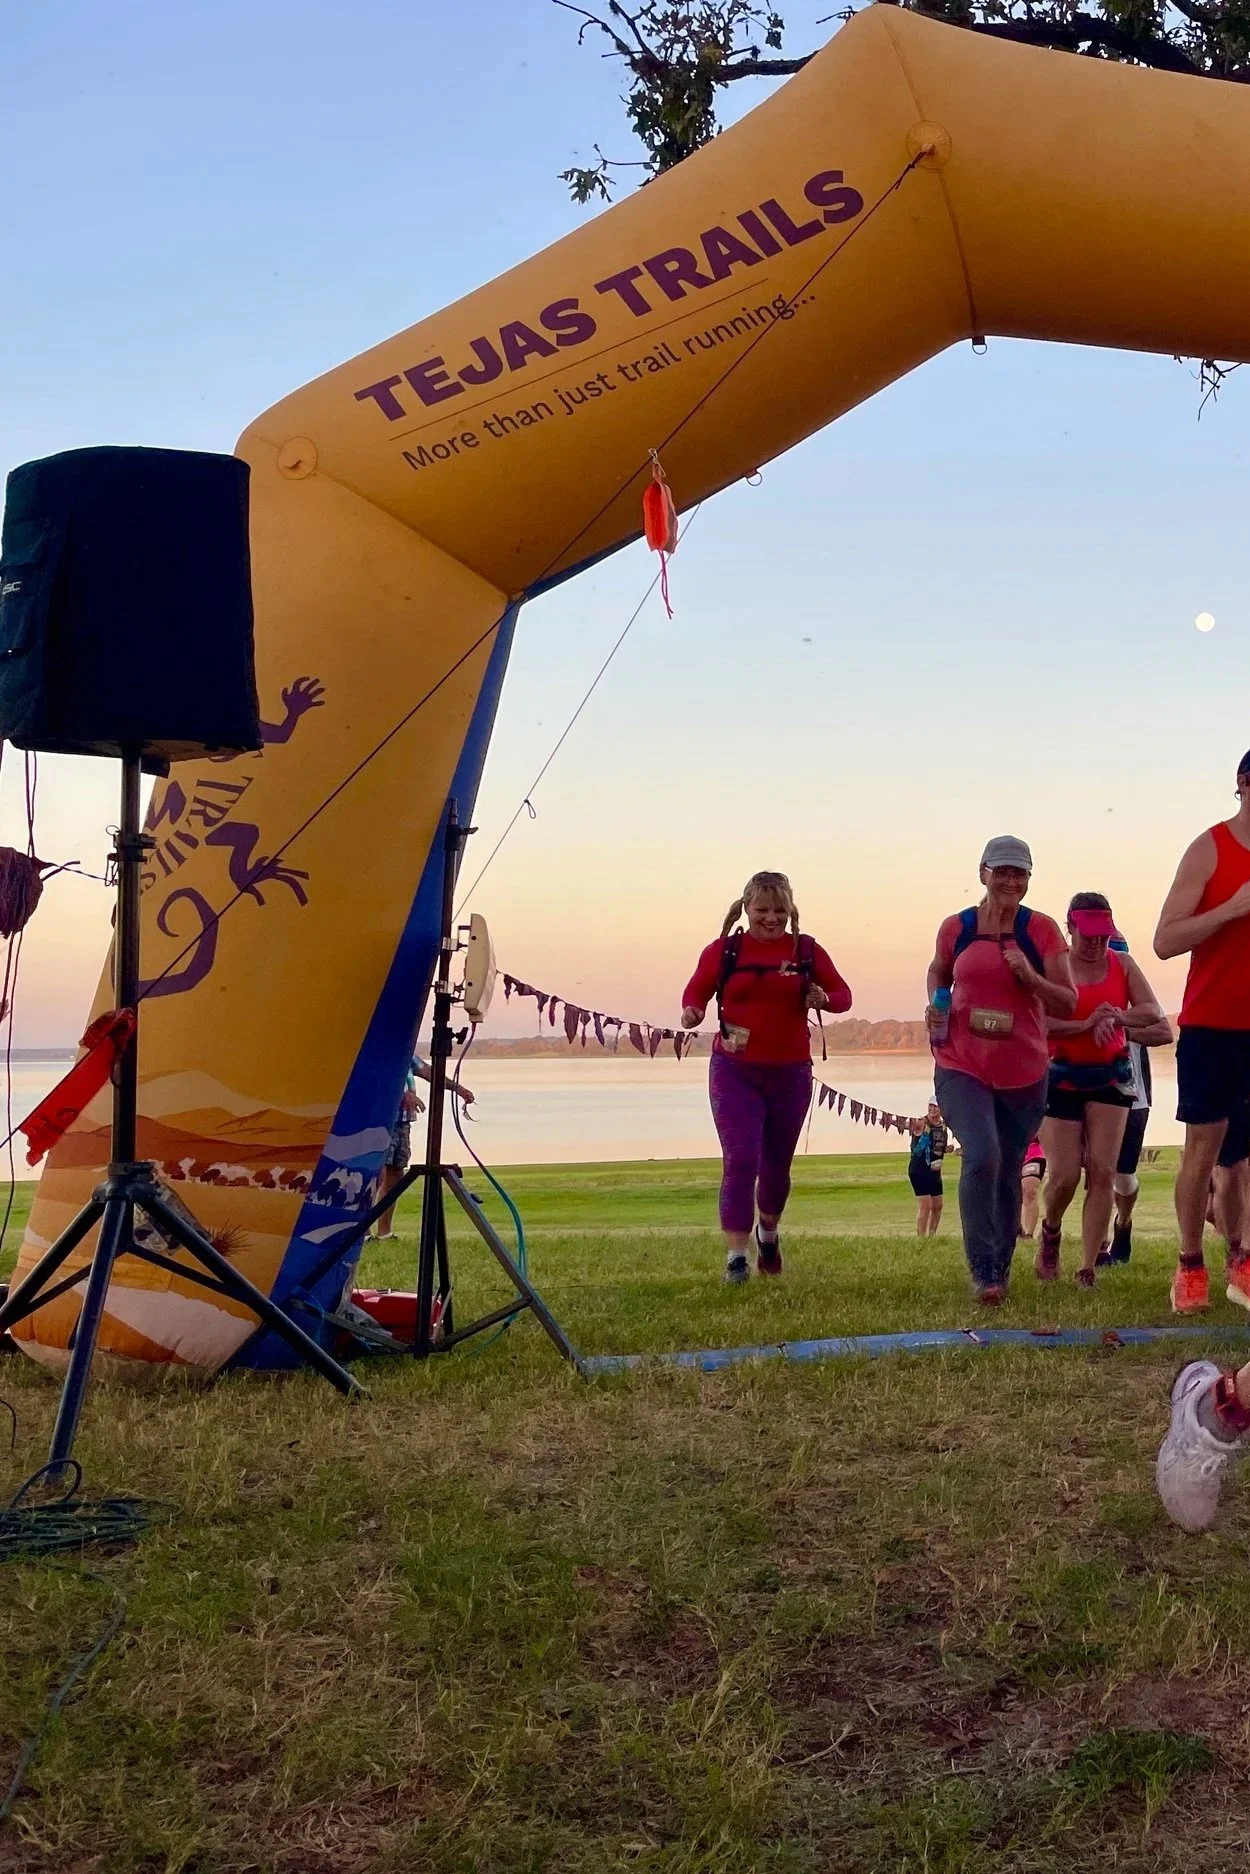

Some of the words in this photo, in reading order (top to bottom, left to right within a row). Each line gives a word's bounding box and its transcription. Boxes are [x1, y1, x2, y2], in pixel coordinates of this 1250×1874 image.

[354, 298, 598, 422] TEJAS
[594, 170, 864, 317] TRAILS
[402, 434, 480, 470] More
[483, 402, 554, 439] than
[559, 373, 616, 416] just
[617, 342, 682, 382] trail
[684, 293, 816, 355] running...
[984, 1019, 997, 1029] 97
